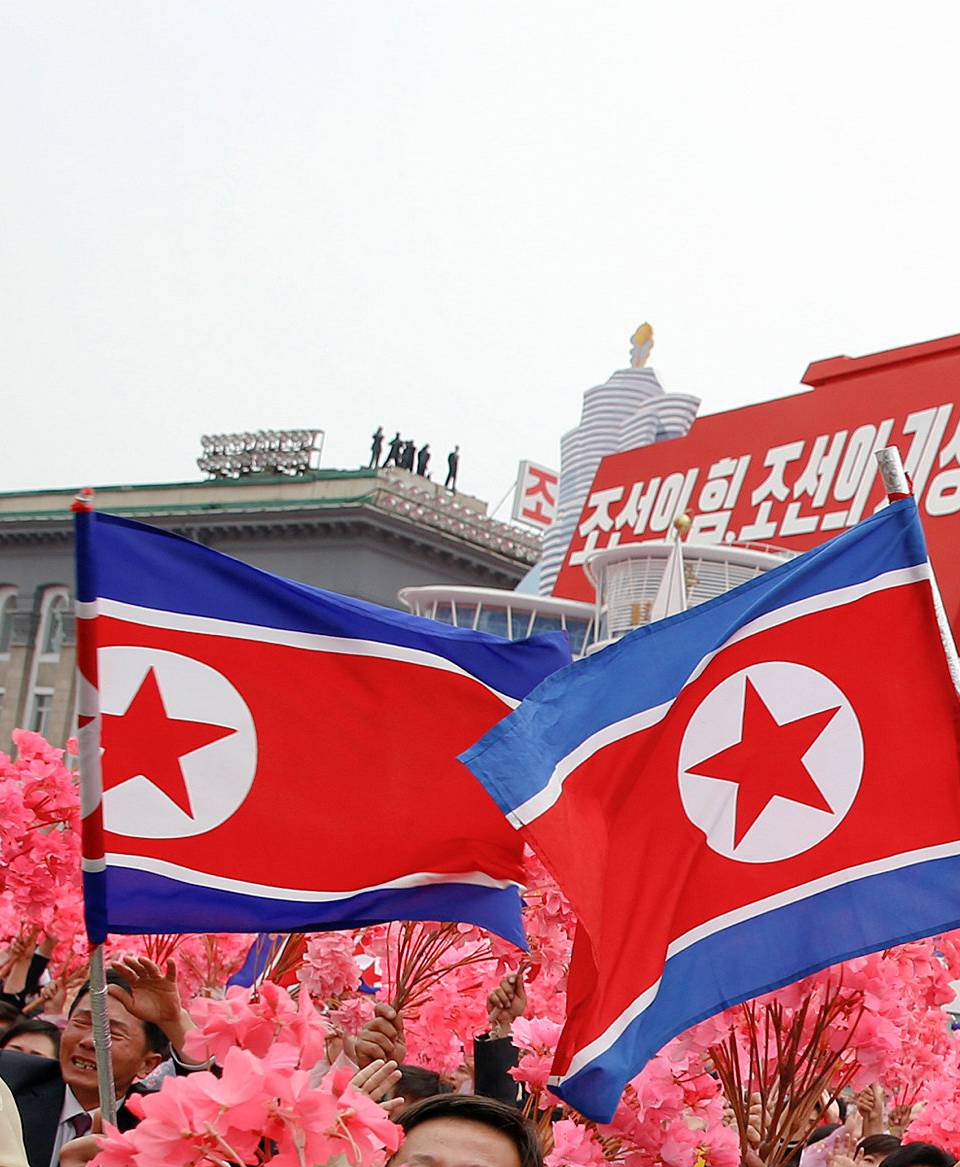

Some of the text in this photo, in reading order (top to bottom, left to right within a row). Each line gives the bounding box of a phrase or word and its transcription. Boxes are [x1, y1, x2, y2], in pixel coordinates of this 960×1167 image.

[521, 466, 558, 526] 조
[568, 468, 699, 567] 조선의
[738, 418, 895, 541] 조선의
